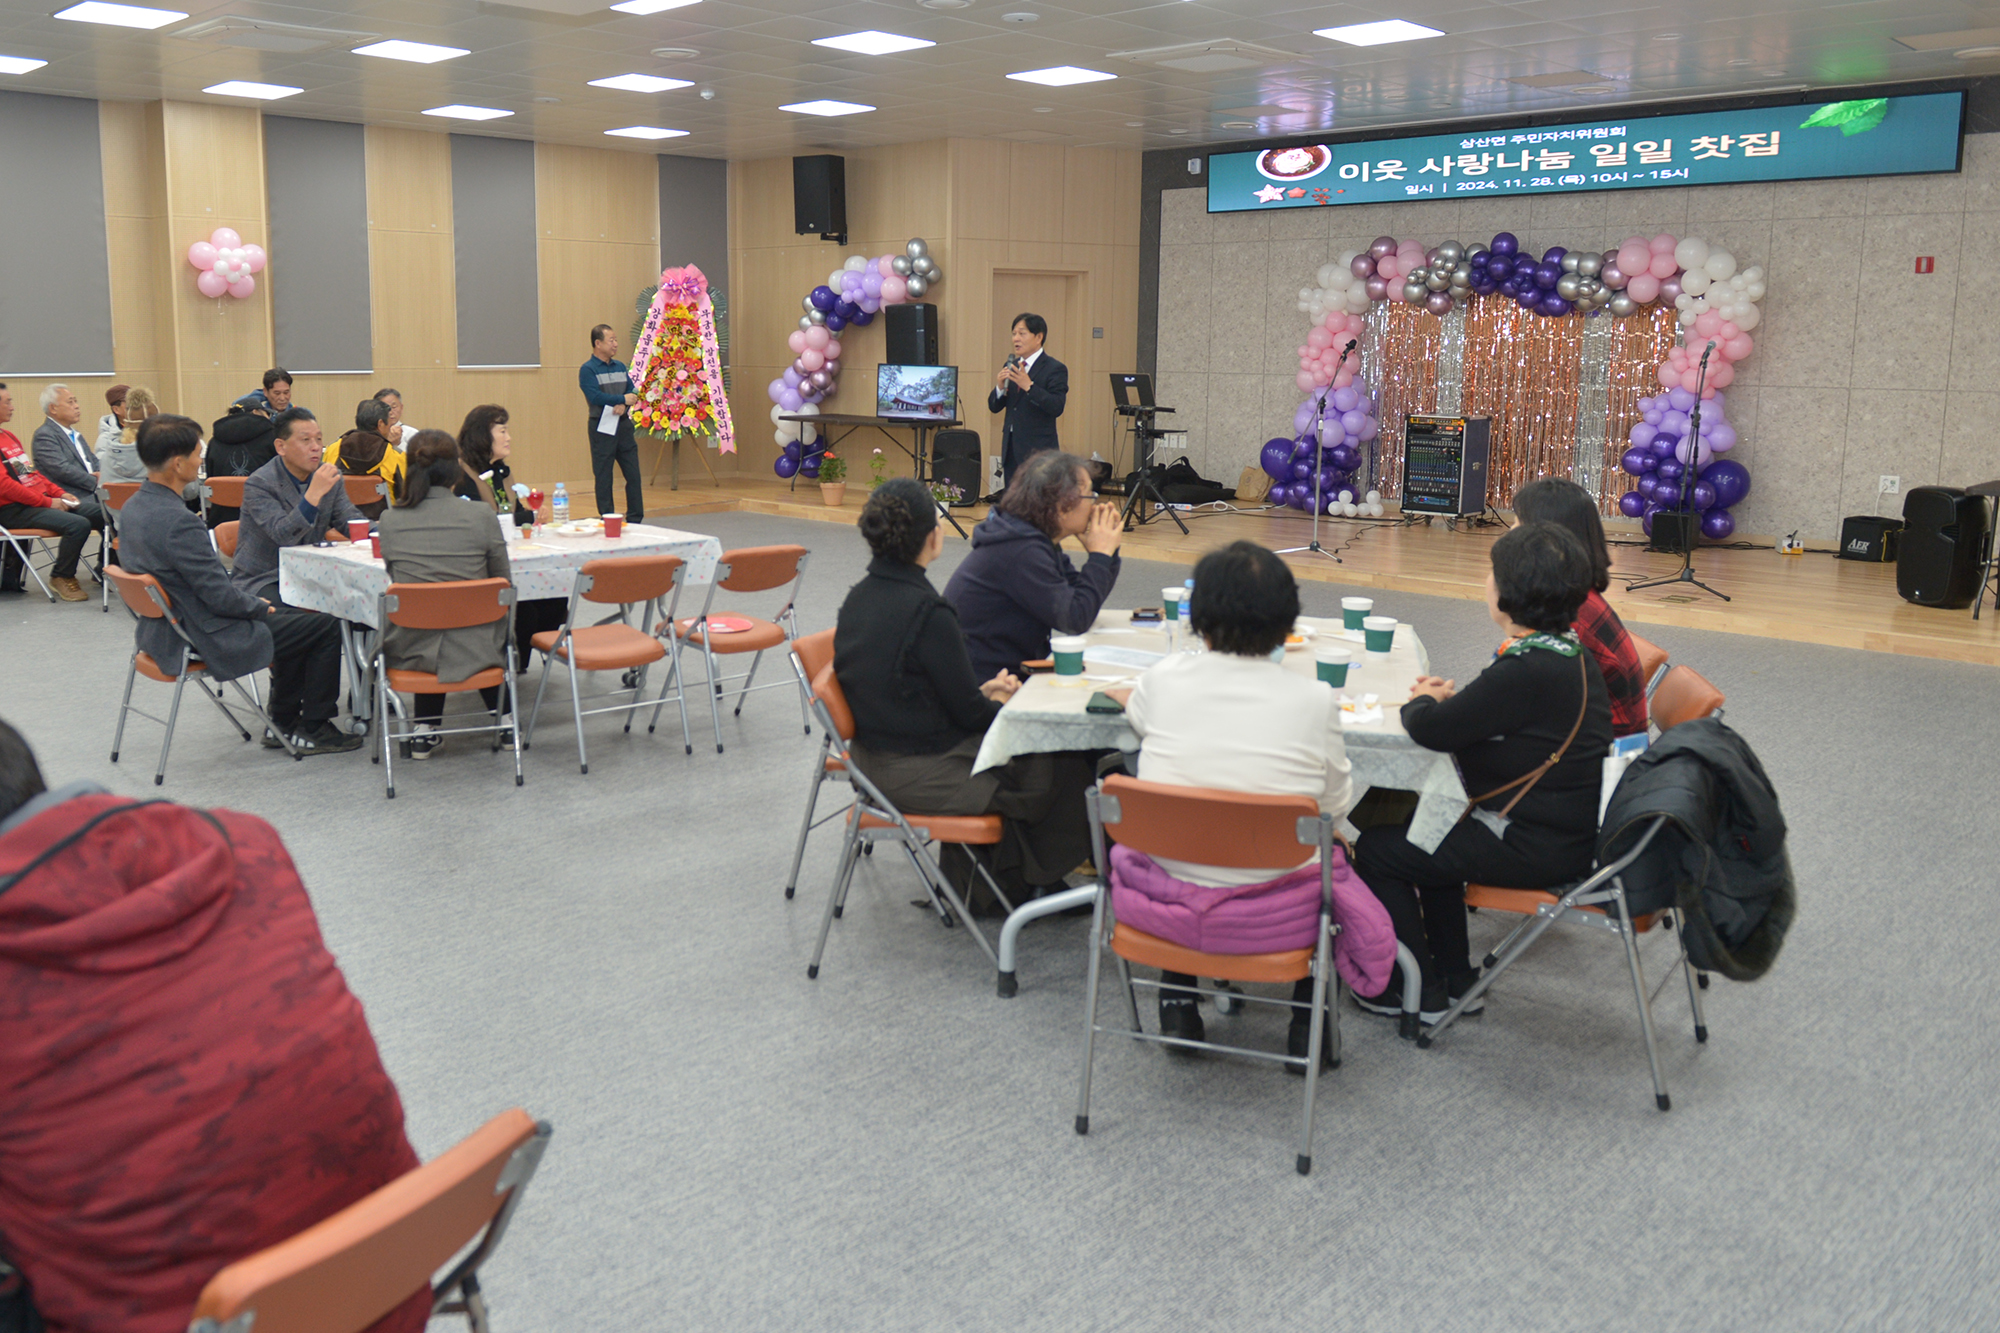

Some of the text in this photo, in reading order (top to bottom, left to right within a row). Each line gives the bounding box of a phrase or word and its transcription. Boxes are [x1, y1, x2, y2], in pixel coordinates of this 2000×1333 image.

[1339, 130, 1781, 182] 이웃 사랑나눔 일일 찻집
[1459, 125, 1627, 149] 삼산면 주민자치위원회
[1404, 183, 1434, 195] 일시
[1456, 179, 1499, 192] 2024.
[1503, 177, 1527, 188] 11.
[1530, 176, 1555, 187] 28.
[1557, 173, 1586, 186] (목)
[1590, 171, 1628, 183] 10시
[1649, 167, 1689, 179] 15시
[701, 309, 731, 442] 무궁한 발전을 기원합니다
